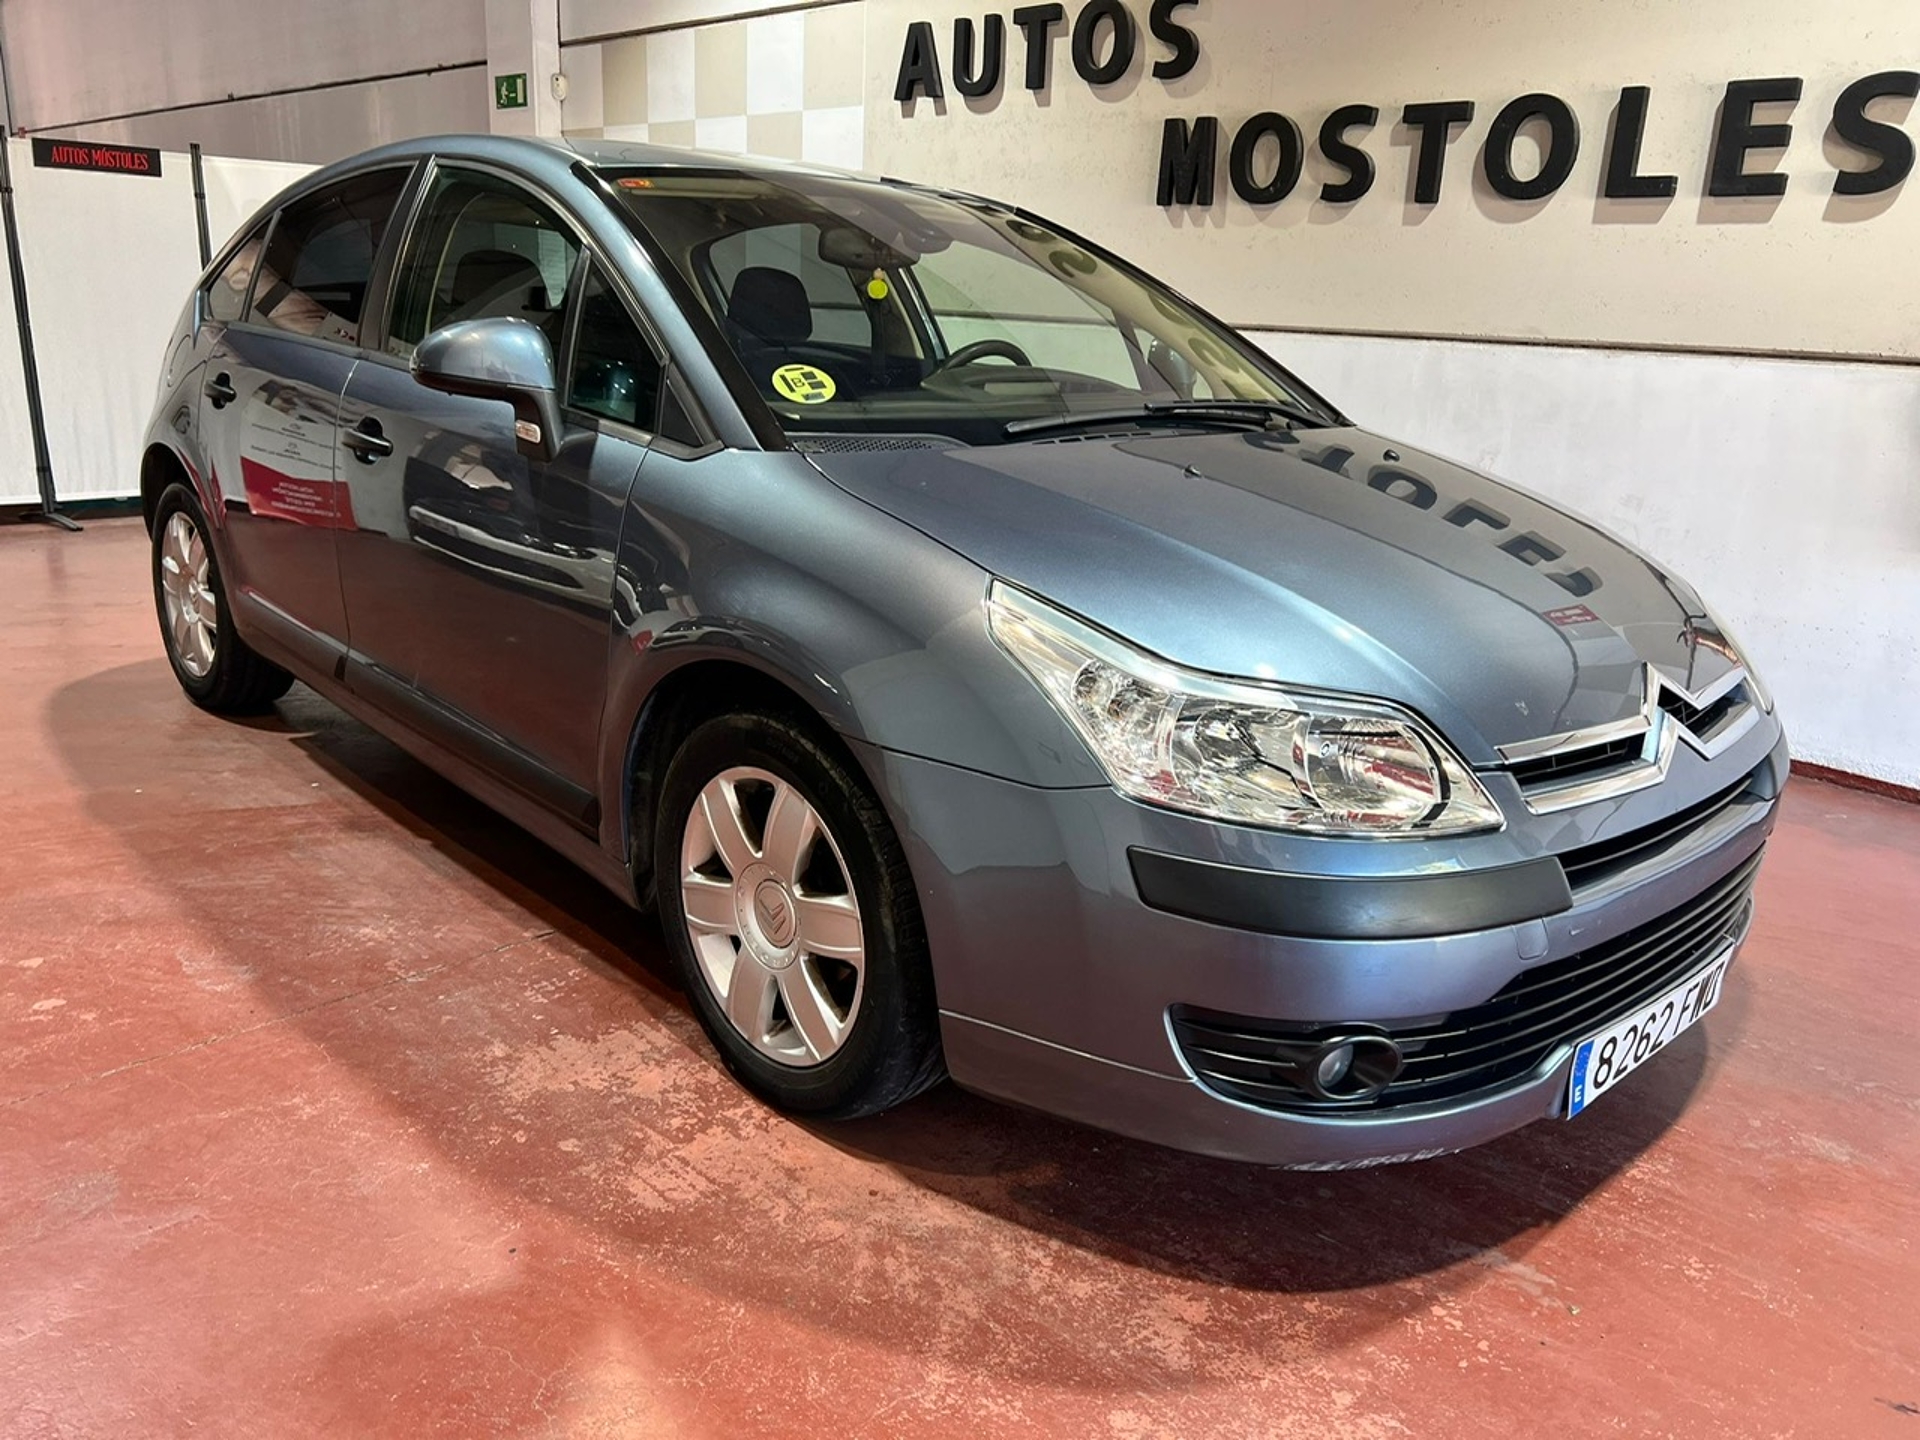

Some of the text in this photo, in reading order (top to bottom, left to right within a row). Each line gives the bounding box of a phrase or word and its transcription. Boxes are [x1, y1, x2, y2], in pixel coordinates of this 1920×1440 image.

[893, 0, 1200, 101] AUTOS
[51, 145, 149, 170] AUTOS MÓSTOLES
[1156, 70, 1920, 207] MOSTOLES
[1593, 1001, 1675, 1090] 8262
[1574, 1084, 1583, 1103] E
